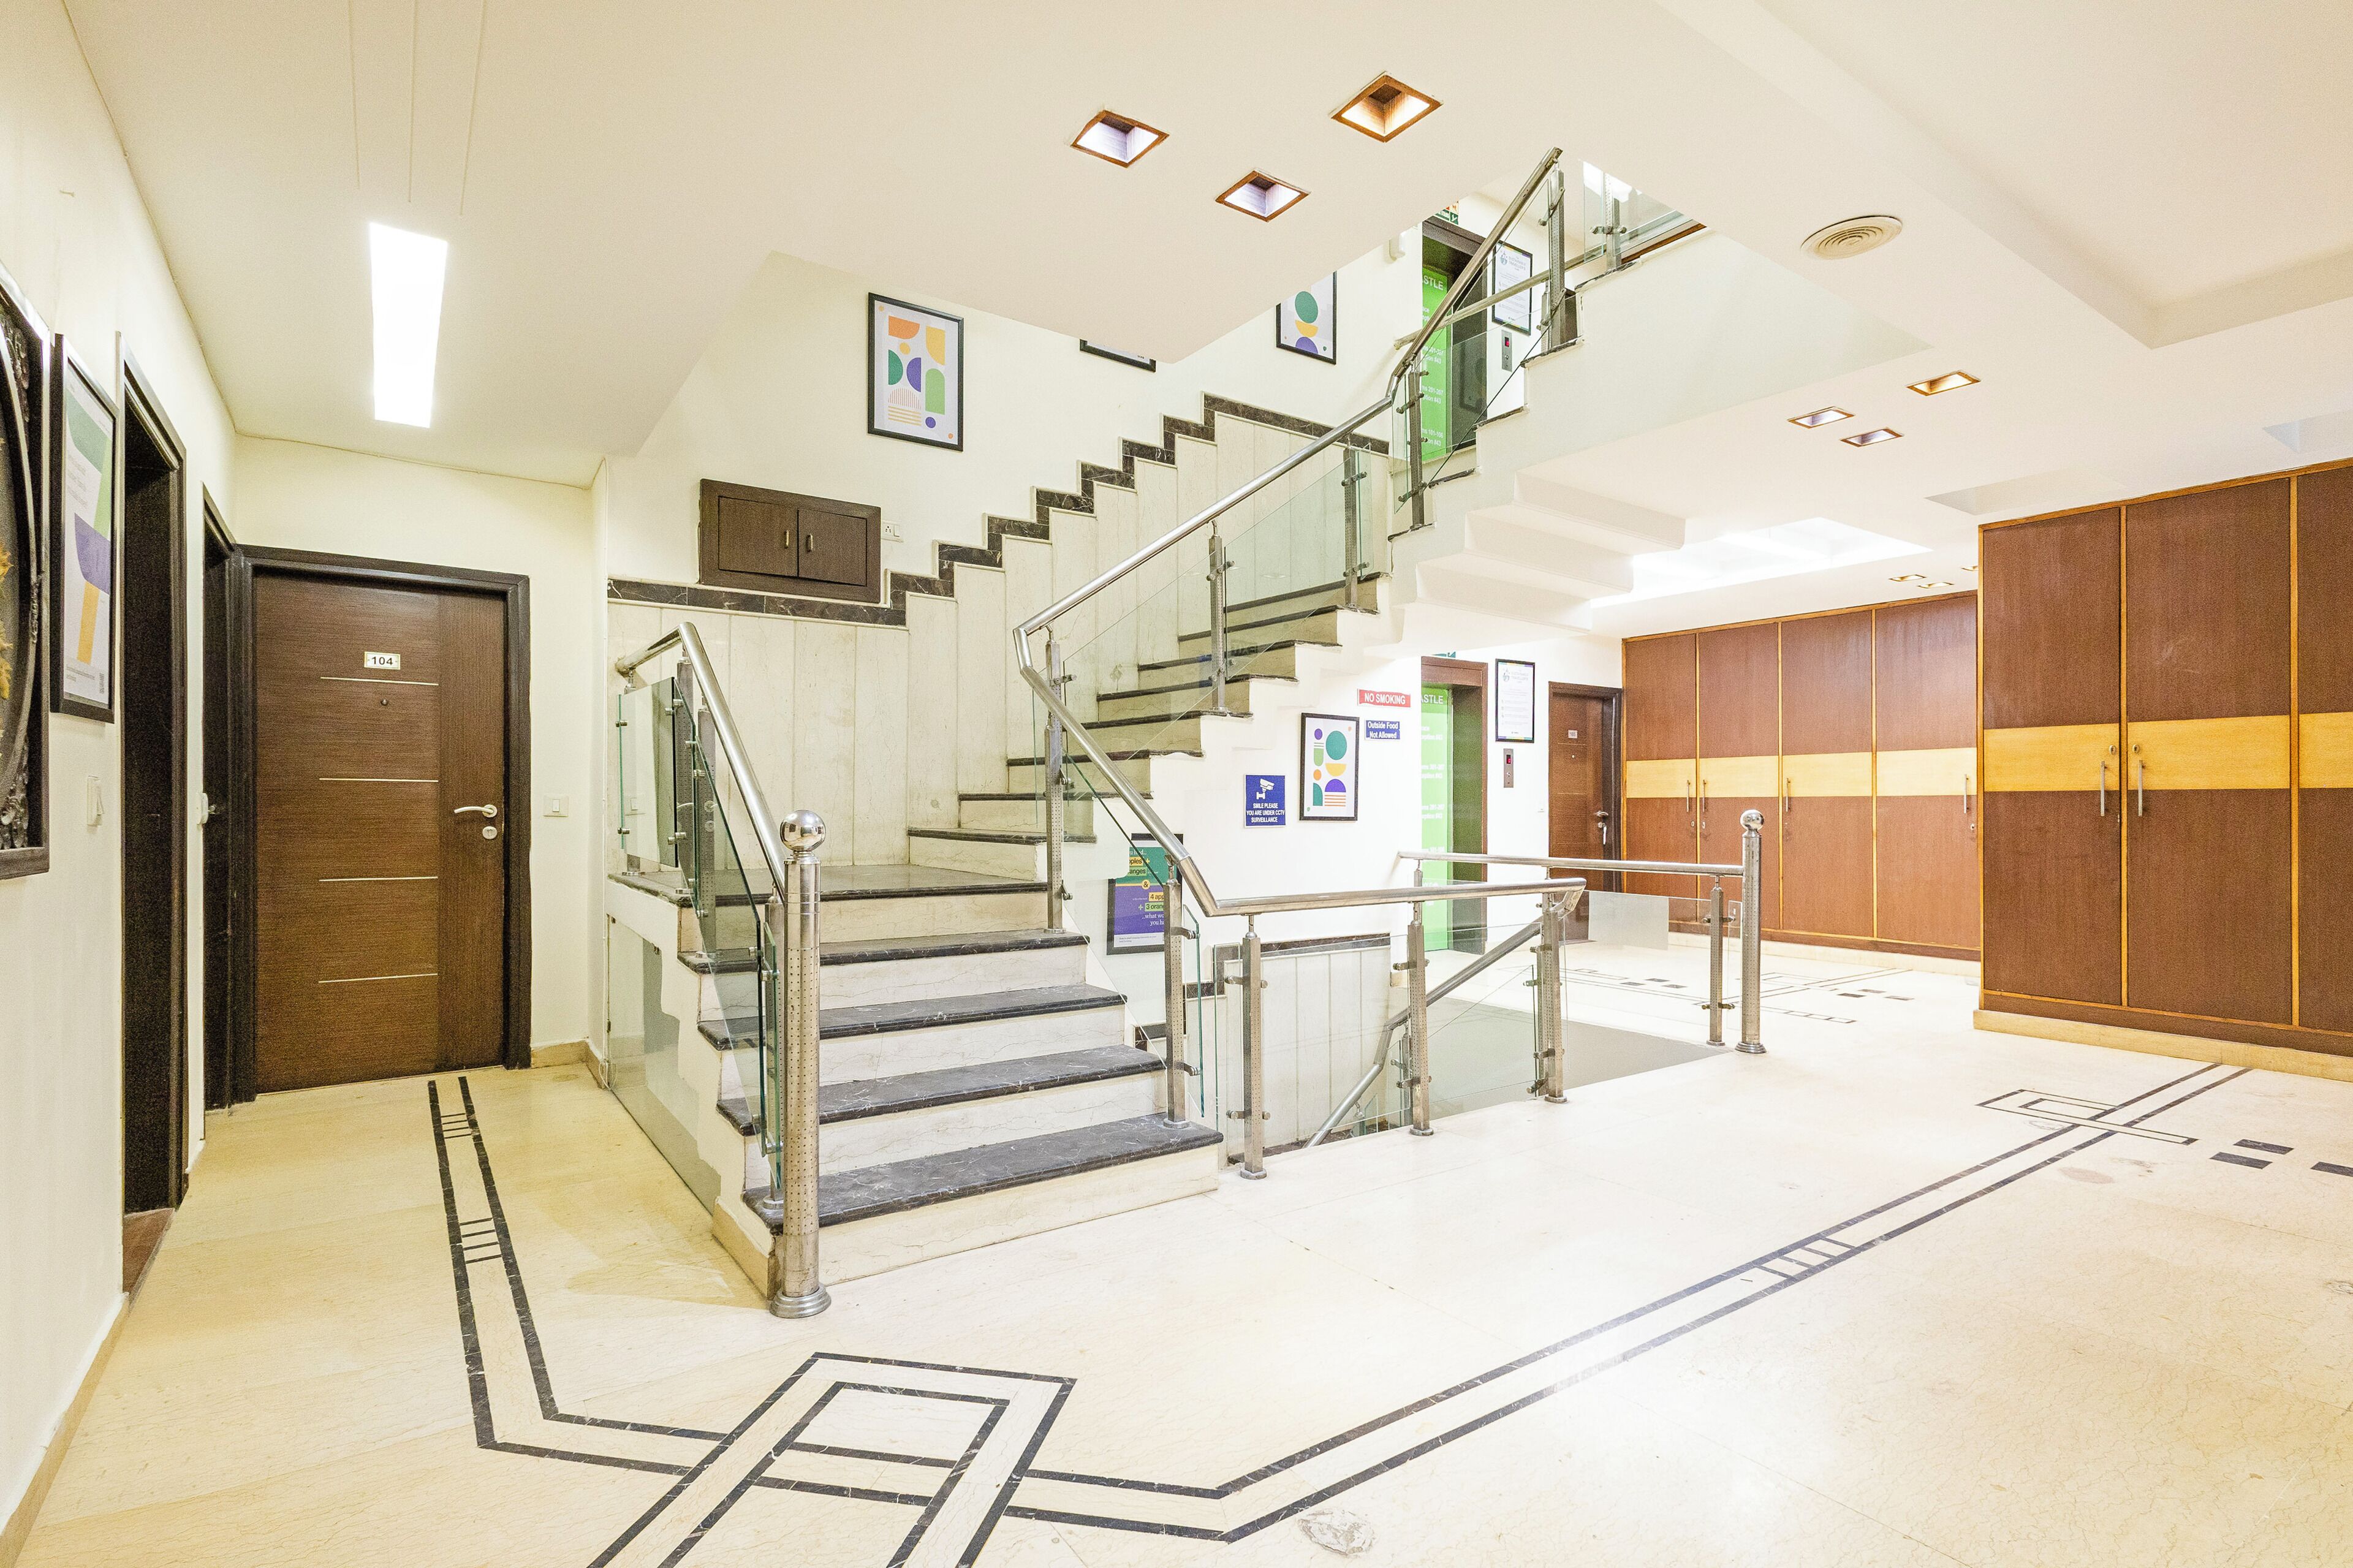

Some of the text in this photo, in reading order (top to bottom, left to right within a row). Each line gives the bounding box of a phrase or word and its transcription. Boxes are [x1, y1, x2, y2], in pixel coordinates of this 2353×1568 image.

[1422, 275, 1444, 290] STLE
[371, 656, 393, 665] 104
[1364, 692, 1406, 705] NO SMOKING
